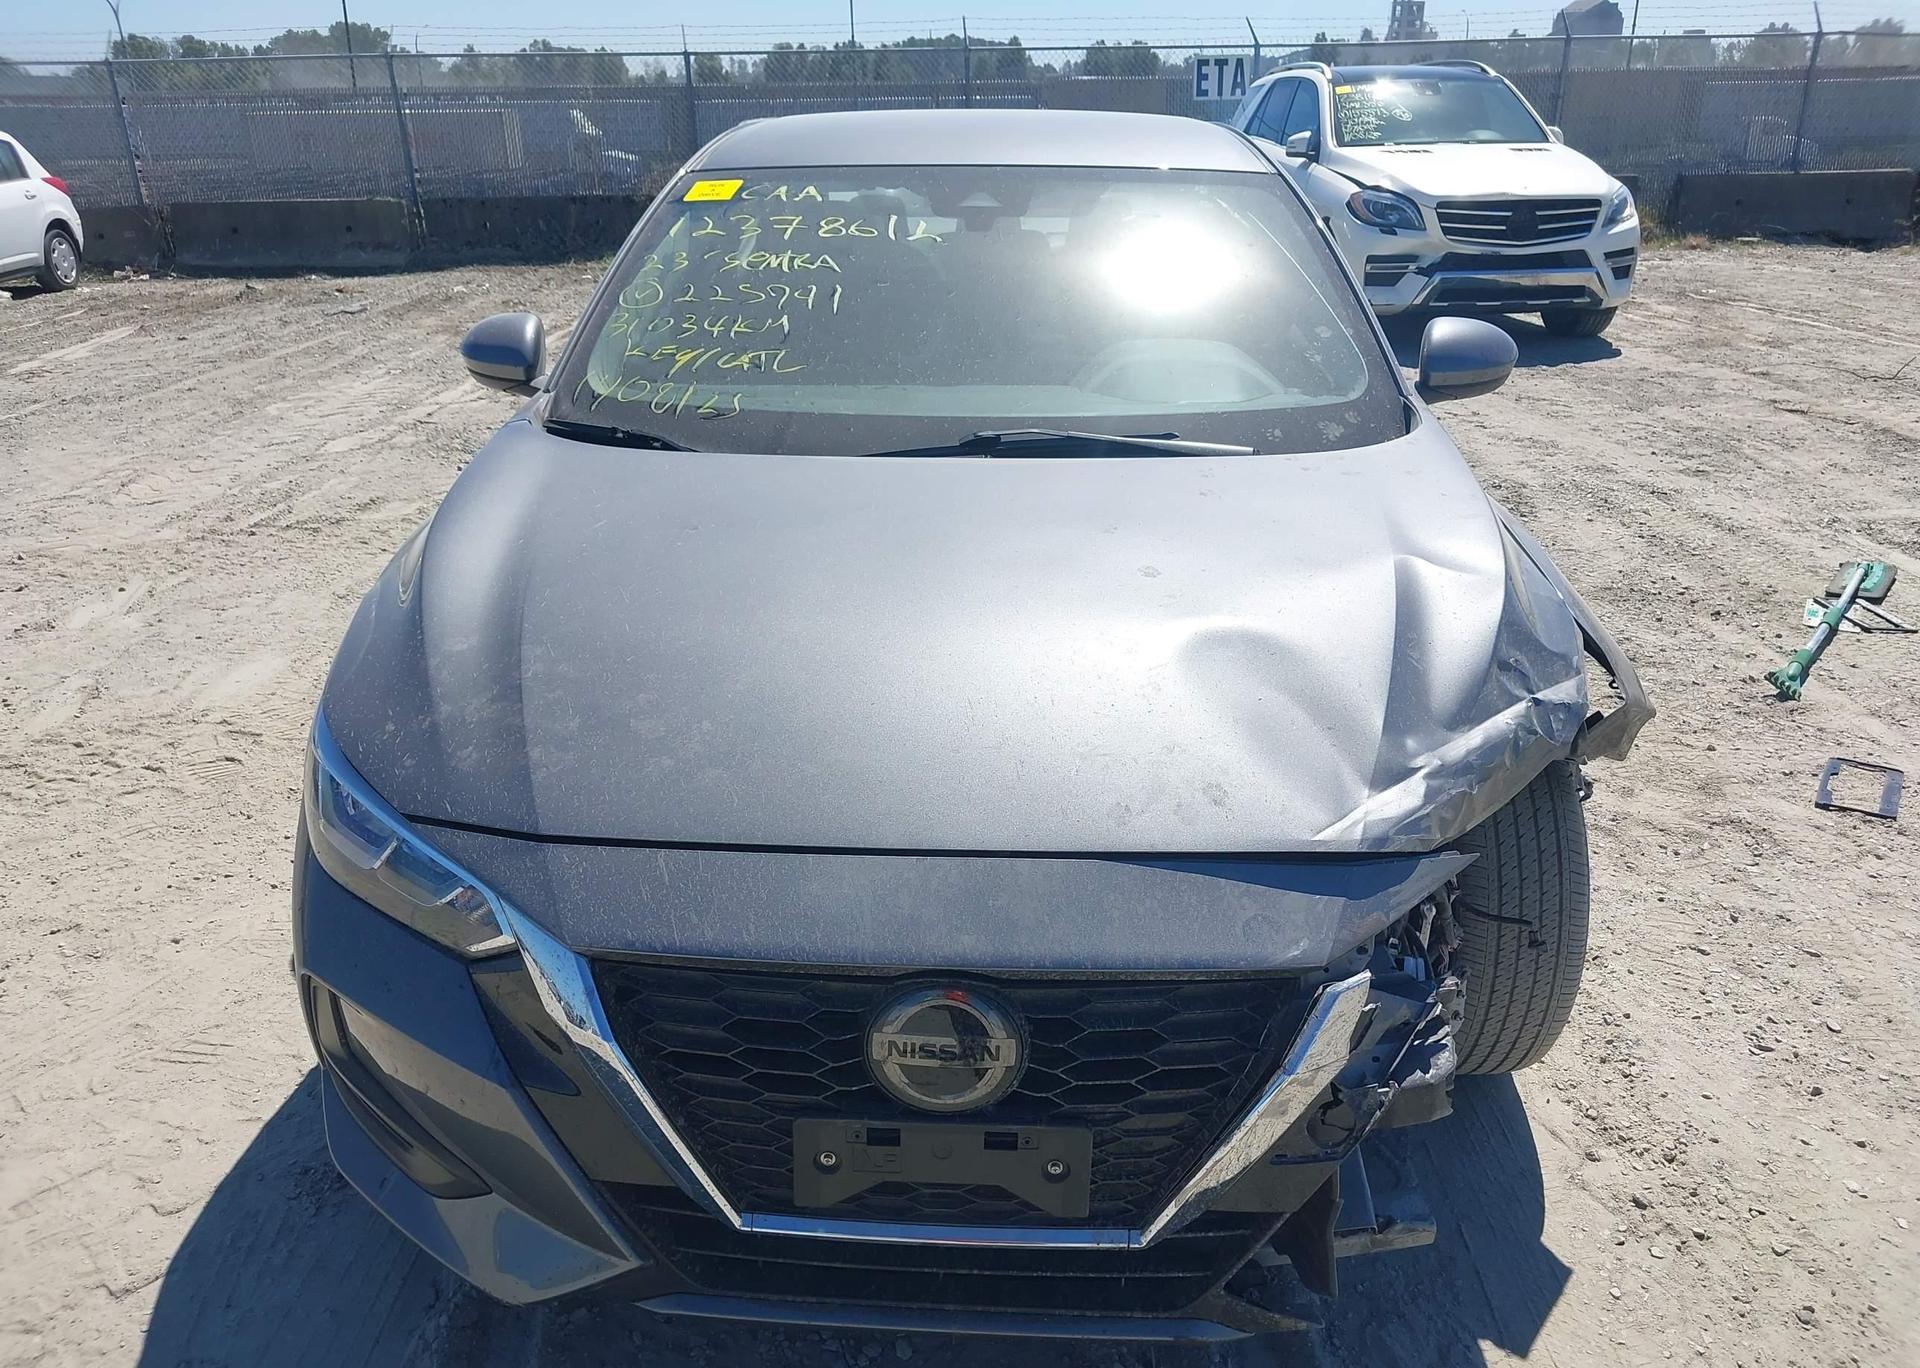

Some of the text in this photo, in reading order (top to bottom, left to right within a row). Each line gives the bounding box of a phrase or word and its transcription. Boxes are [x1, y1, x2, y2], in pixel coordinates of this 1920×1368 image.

[1196, 58, 1246, 97] ETA
[741, 185, 824, 202] CAA
[887, 1039, 1001, 1062] NISSAN
